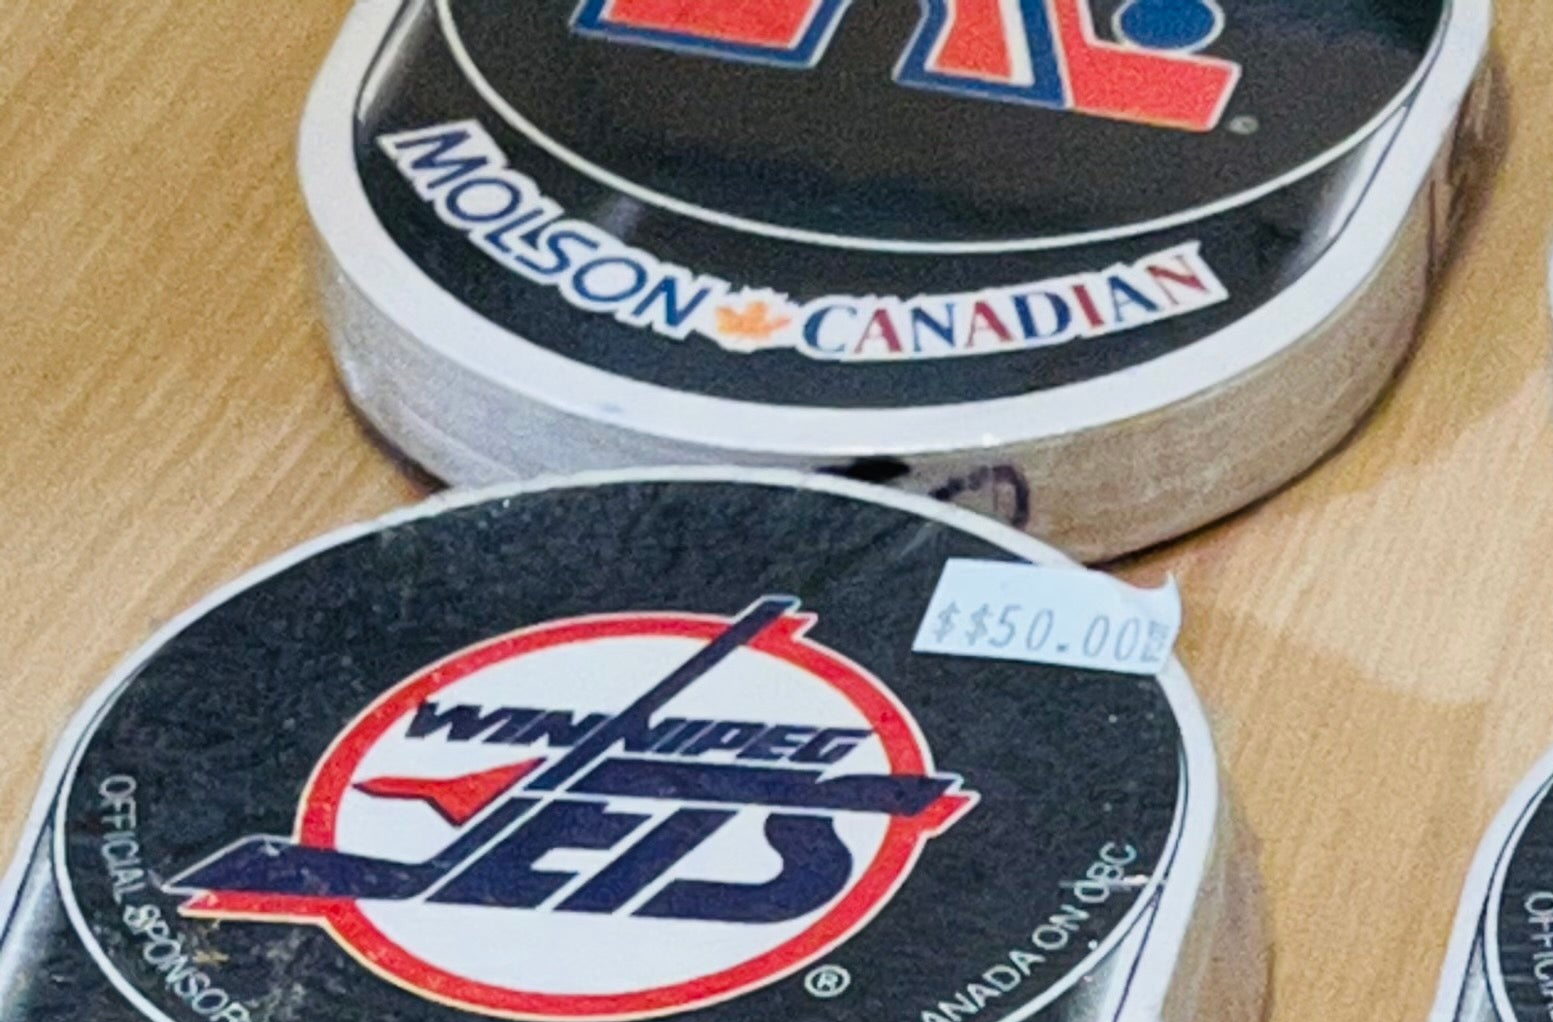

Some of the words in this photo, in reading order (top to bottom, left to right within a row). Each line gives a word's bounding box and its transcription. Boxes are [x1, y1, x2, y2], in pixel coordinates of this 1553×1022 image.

[394, 129, 710, 328] MOLSON
[802, 254, 1210, 355] CANADIAN
[933, 601, 1141, 662] $$50.00
[402, 699, 873, 763] WINNIPEG
[99, 774, 148, 905] OFFICIAL
[1031, 902, 1091, 951] ON
[163, 755, 960, 926] JETS
